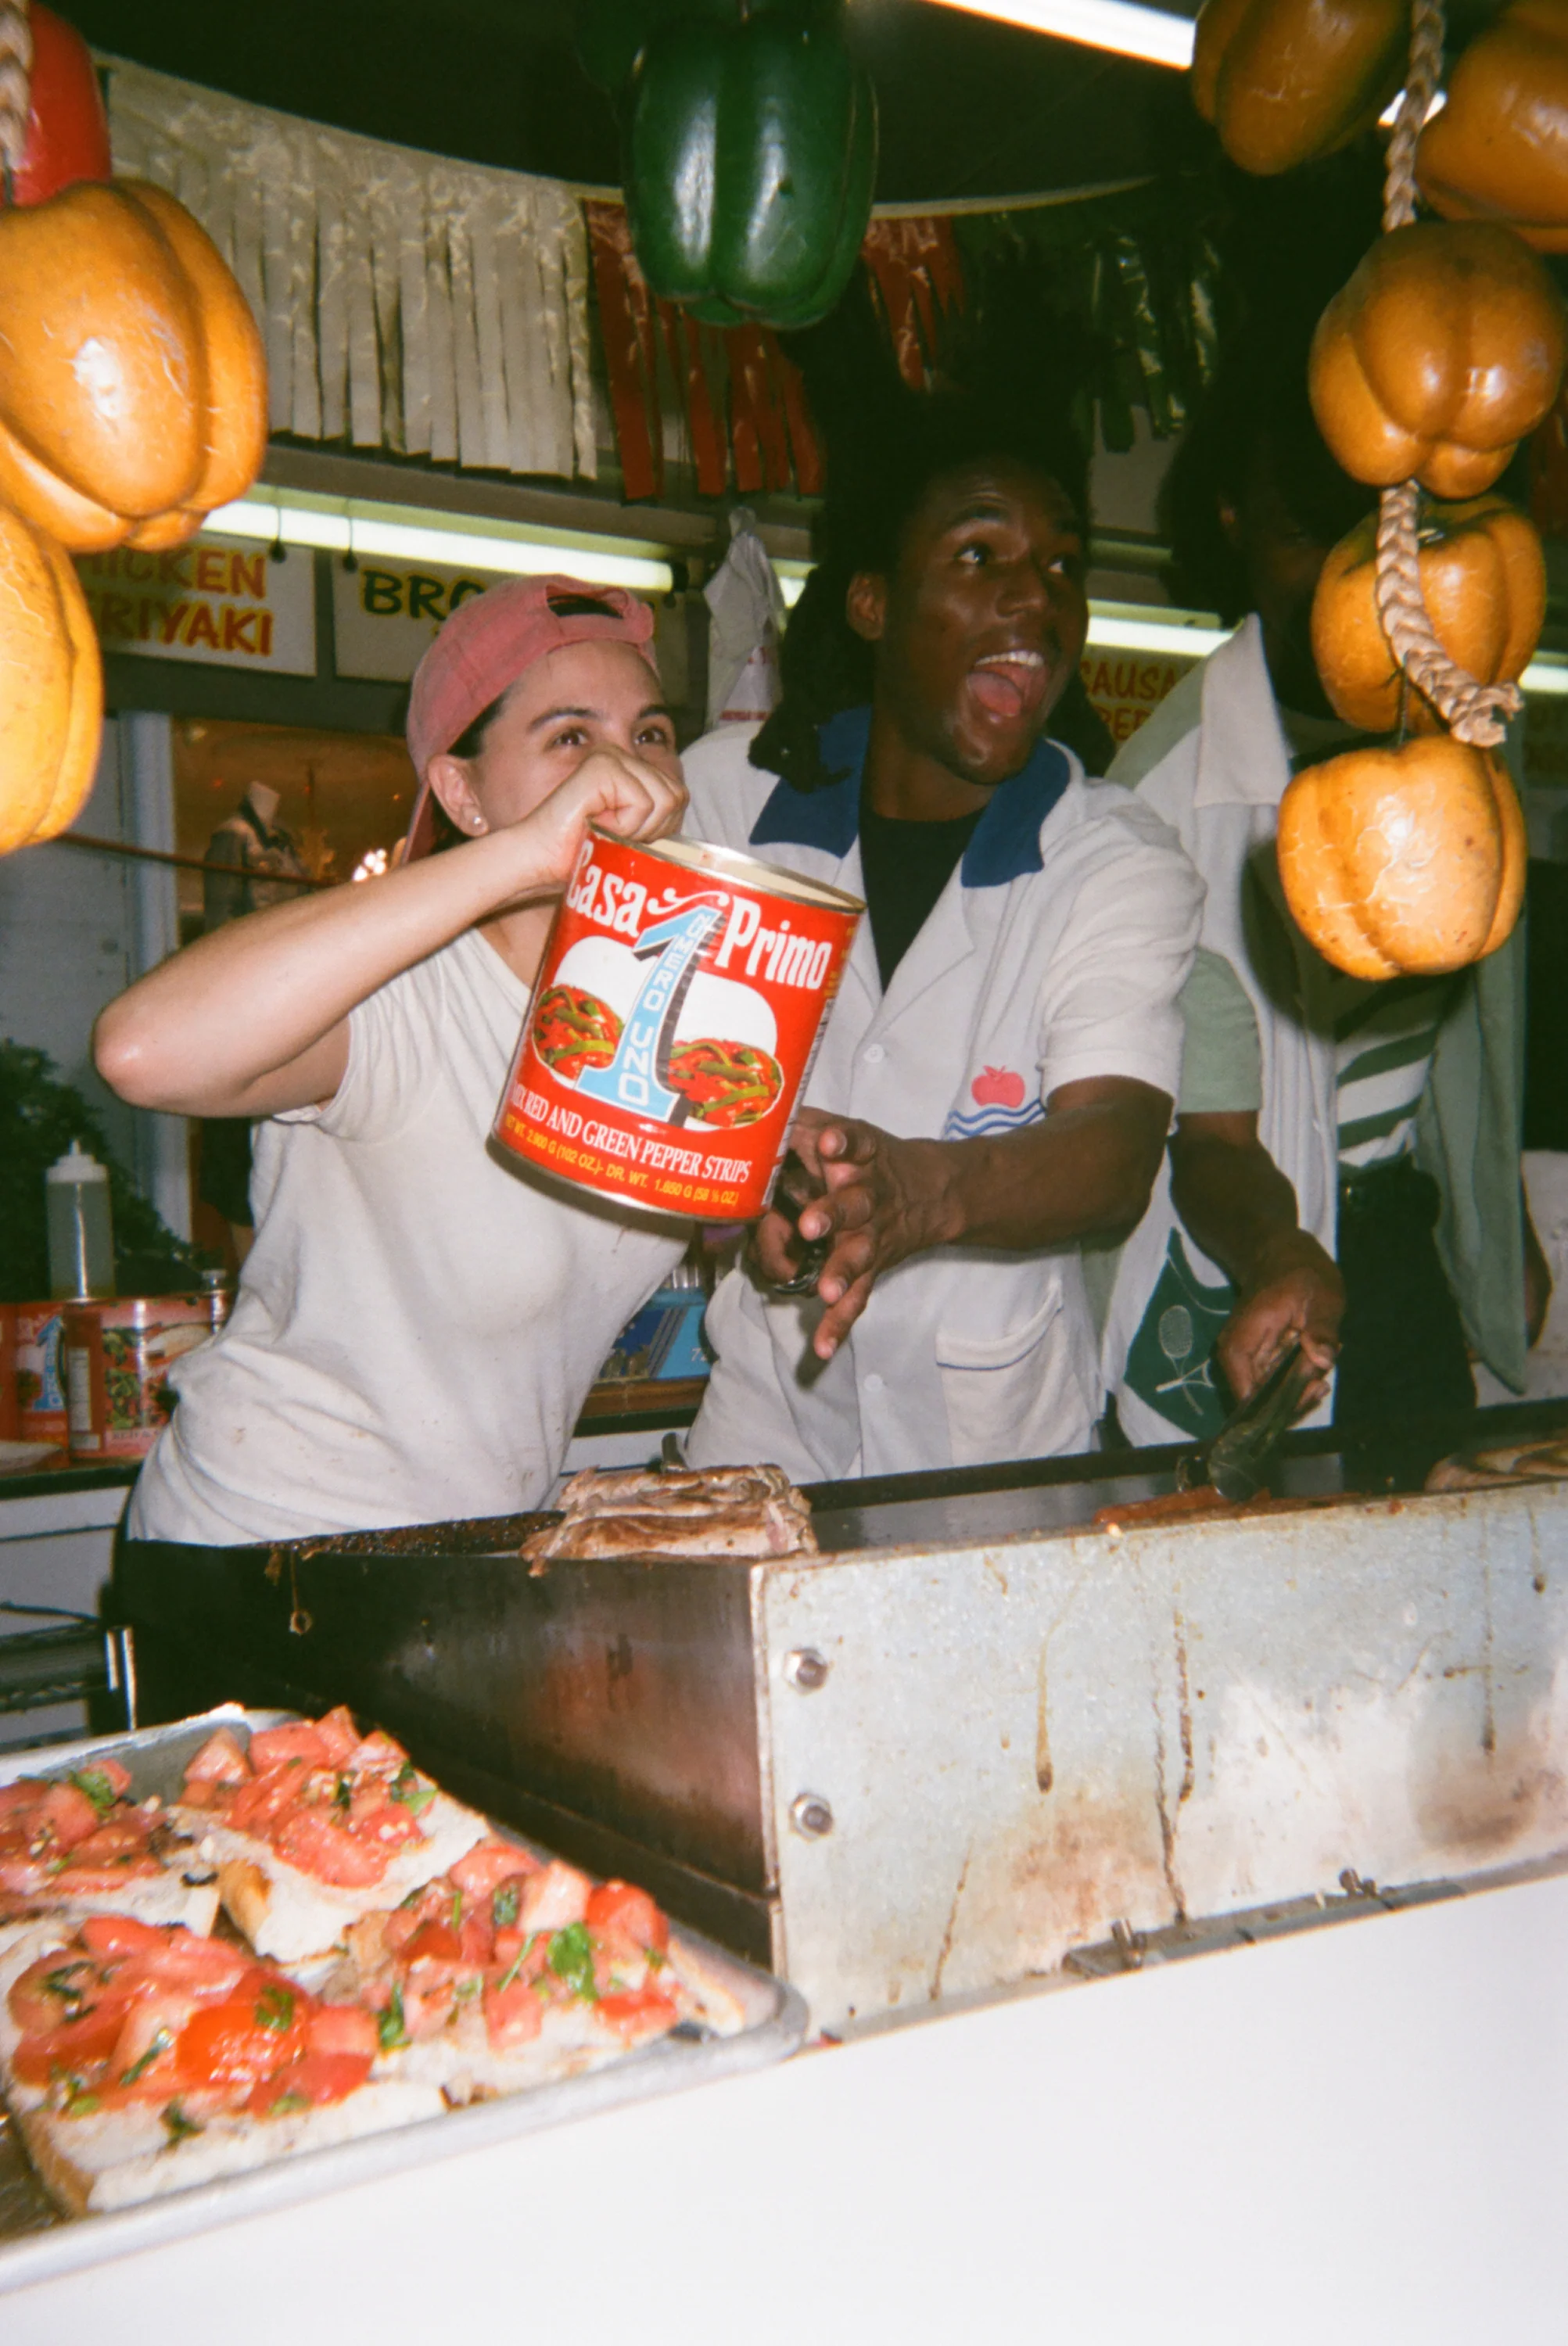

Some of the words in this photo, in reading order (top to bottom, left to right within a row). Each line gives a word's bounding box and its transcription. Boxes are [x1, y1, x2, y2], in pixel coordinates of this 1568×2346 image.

[88, 590, 271, 656] RIYAKI
[566, 839, 648, 938] Casa
[714, 894, 832, 990] Primo
[618, 1021, 655, 1107] UNO
[524, 1091, 548, 1122] RED
[547, 1105, 582, 1138] AND
[583, 1121, 642, 1160] GREEN
[639, 1139, 703, 1177] PEPPER
[701, 1155, 752, 1183] STRIPS
[605, 1163, 626, 1182] DR.
[628, 1171, 649, 1188] WT.
